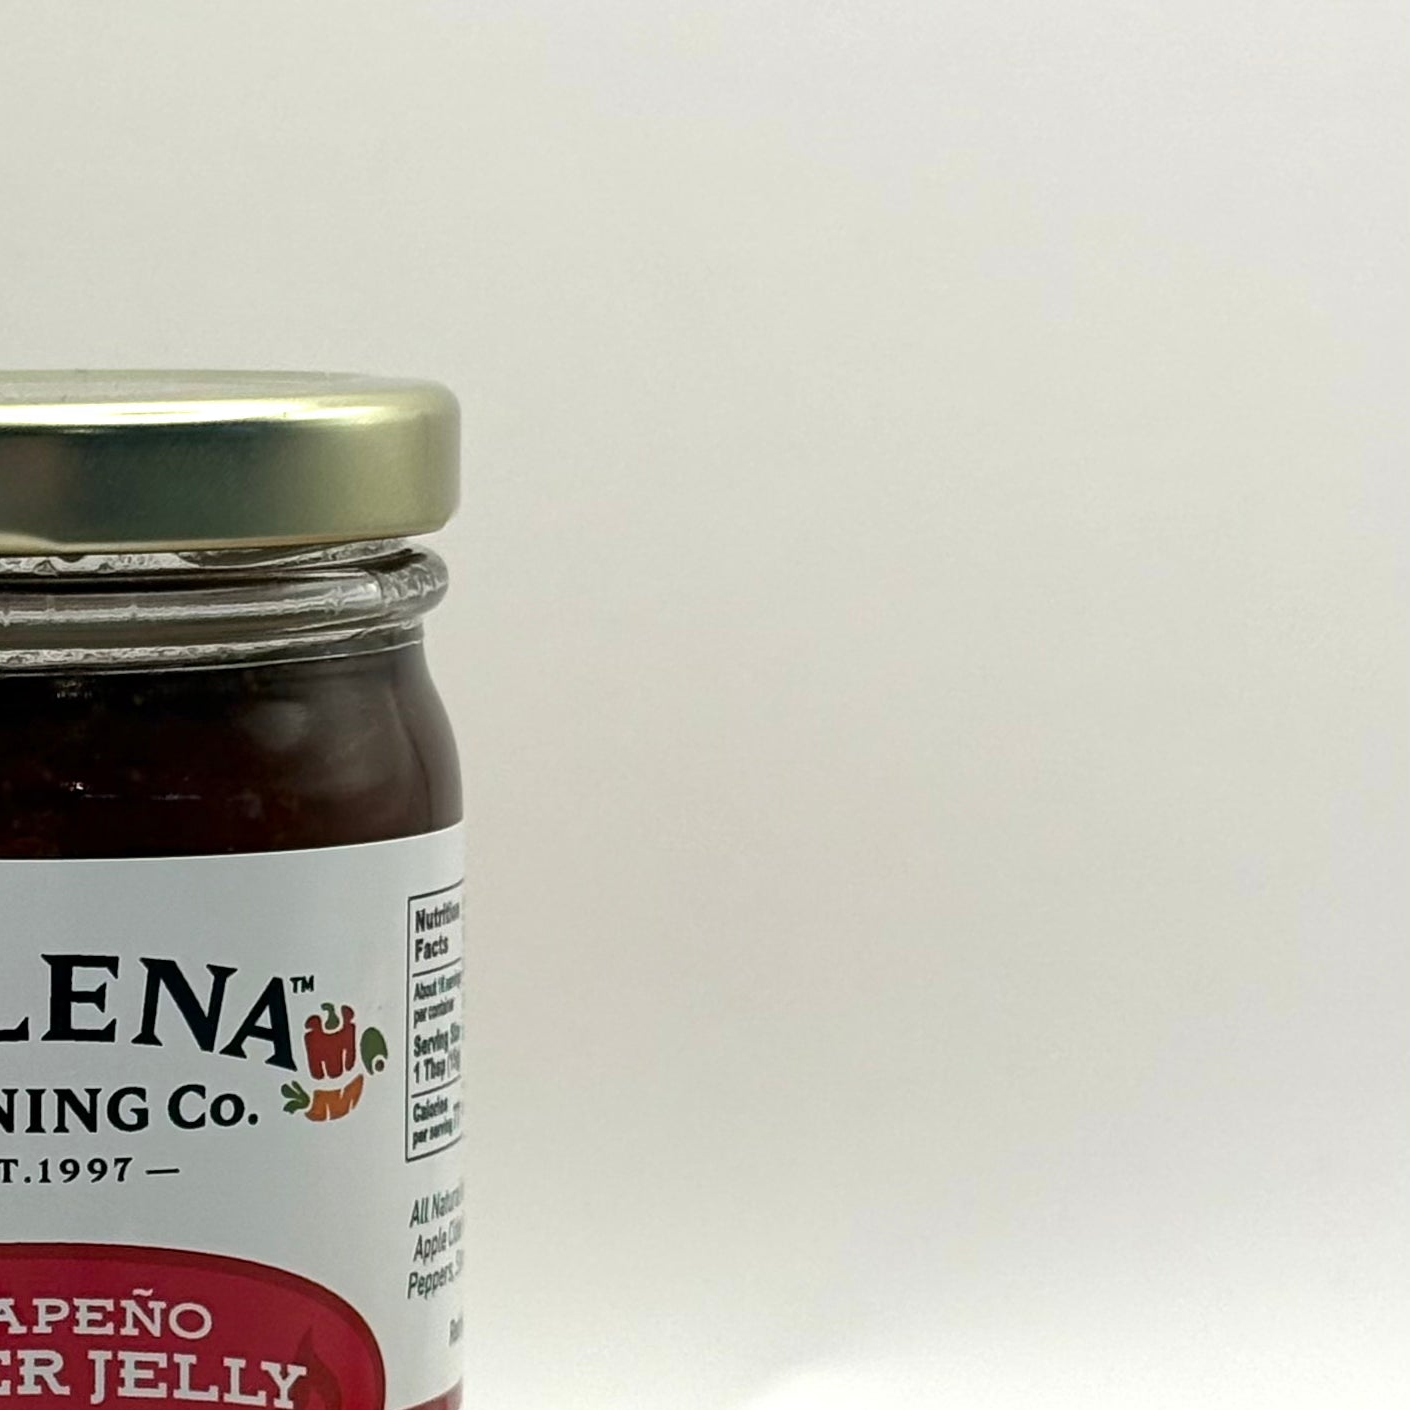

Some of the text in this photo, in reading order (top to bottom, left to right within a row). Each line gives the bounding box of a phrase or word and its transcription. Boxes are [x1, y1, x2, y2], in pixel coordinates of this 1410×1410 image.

[415, 935, 449, 963] Facts
[167, 1083, 259, 1132] Co.
[408, 1195, 430, 1229] All
[412, 1226, 447, 1266] Apple
[87, 1349, 309, 1410] JELLY
